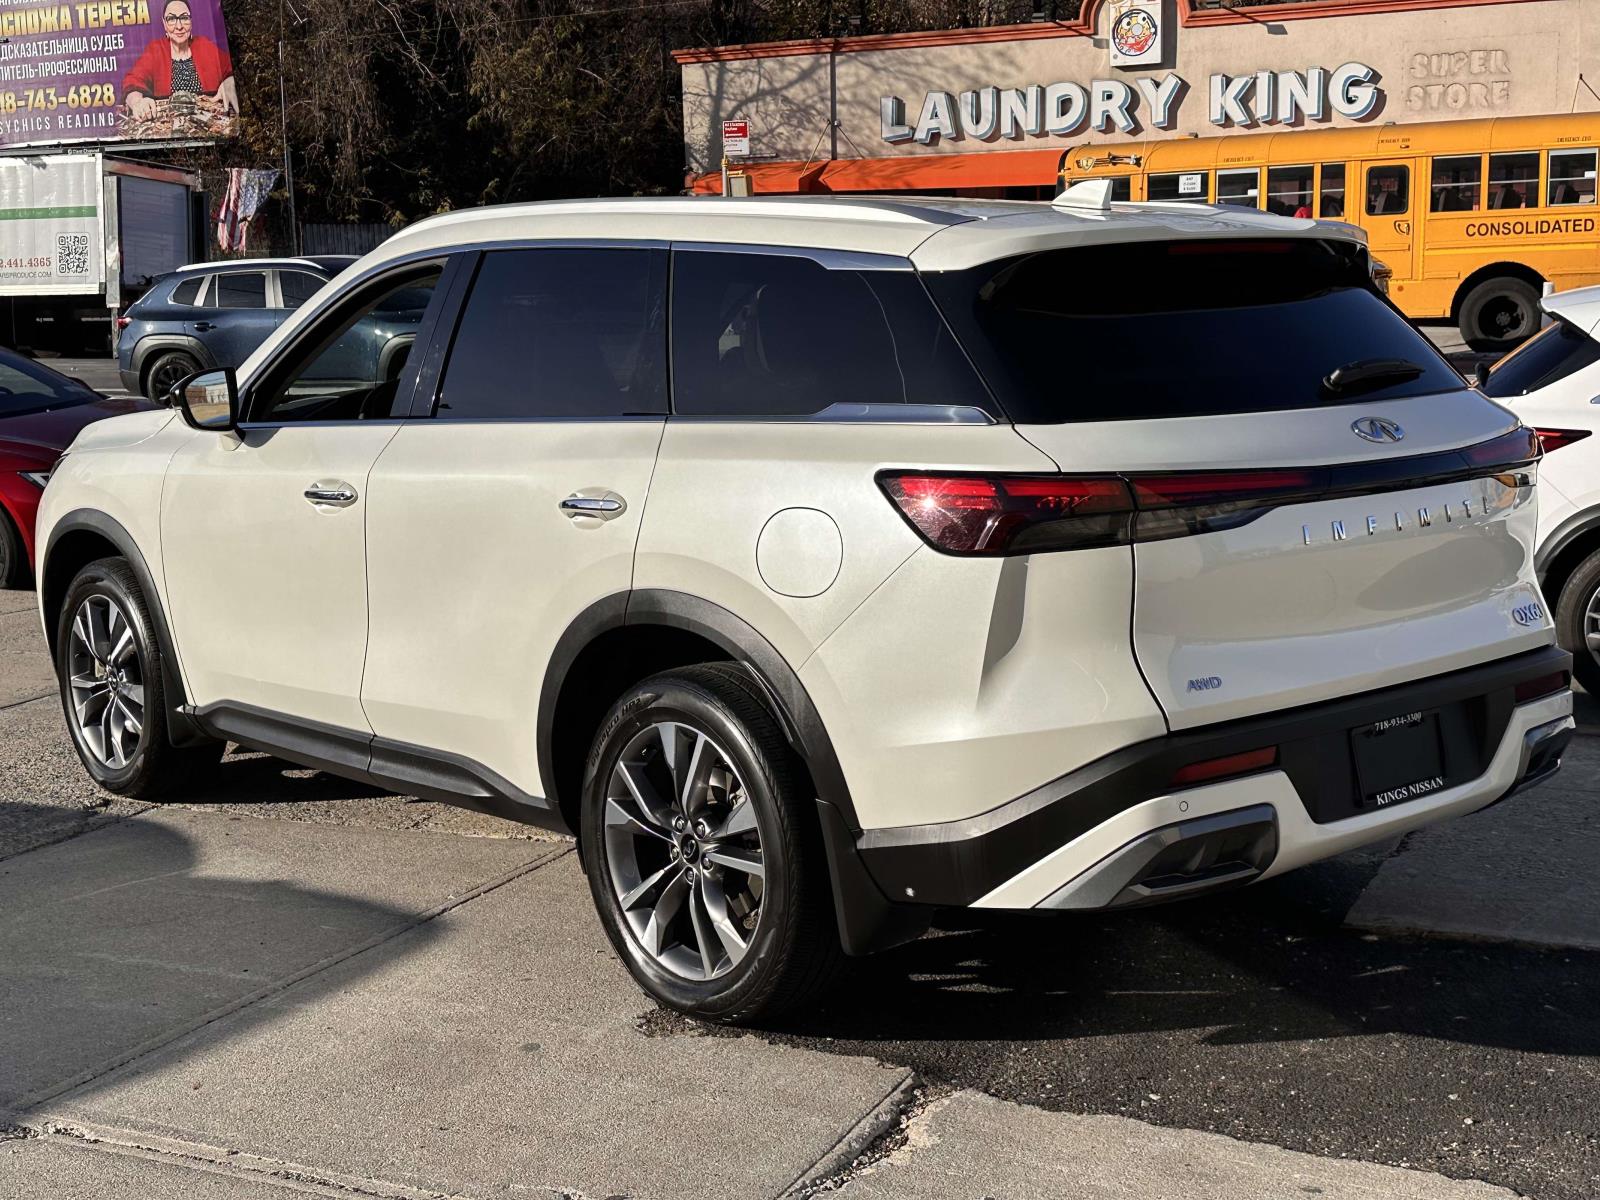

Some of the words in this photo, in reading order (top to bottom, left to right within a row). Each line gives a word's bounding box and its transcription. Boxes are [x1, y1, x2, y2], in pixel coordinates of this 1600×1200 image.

[0, 4, 73, 37] СПОЖА
[75, 0, 150, 29] ТЕРЕЗА
[91, 34, 124, 51] СУДЕБ
[1409, 49, 1511, 78] SUPER
[880, 73, 1181, 143] LAUNDRY
[1208, 62, 1378, 126] KING
[1406, 80, 1510, 110] STORE
[58, 112, 114, 129] READING
[1465, 218, 1595, 237] CONSOLIDATED
[1302, 496, 1488, 545] INFINITI
[1186, 676, 1222, 693] AWD
[1376, 787, 1408, 806] KINGS
[1408, 776, 1444, 796] NISSAN
